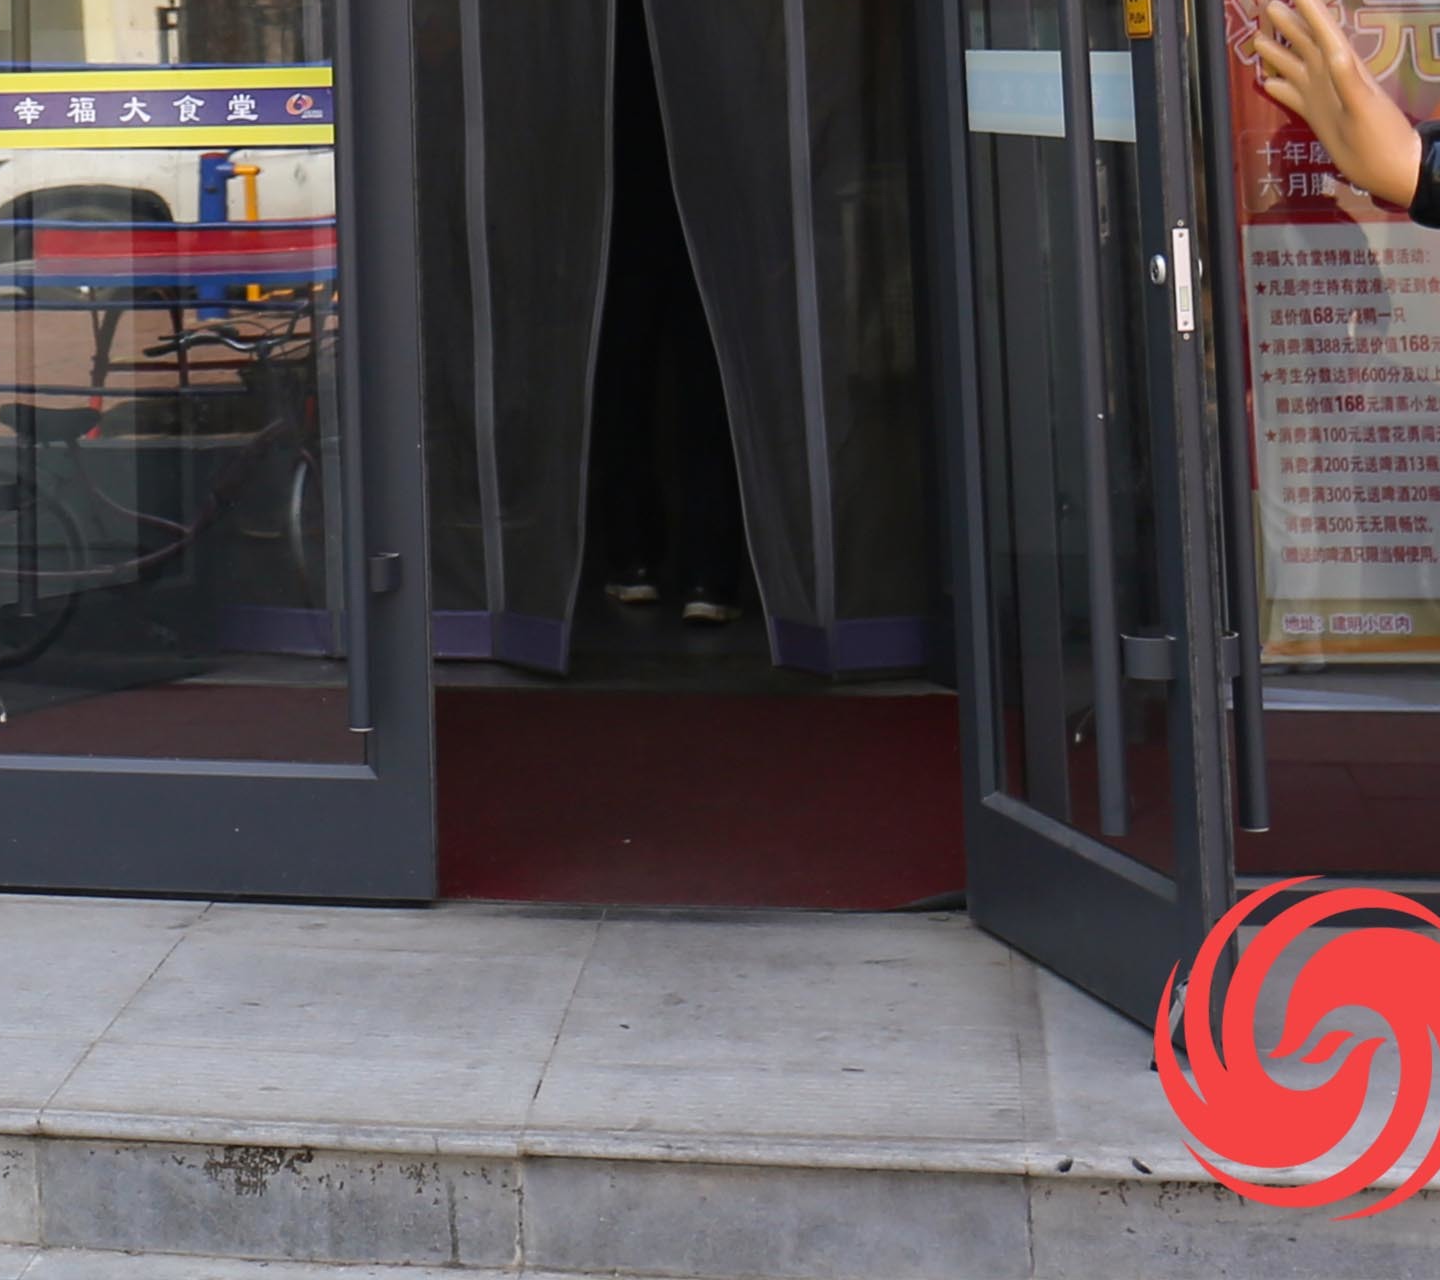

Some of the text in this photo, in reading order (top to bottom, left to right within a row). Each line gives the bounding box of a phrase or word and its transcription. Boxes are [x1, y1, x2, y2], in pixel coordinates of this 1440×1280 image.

[14, 94, 259, 124] 幸福大食堂
